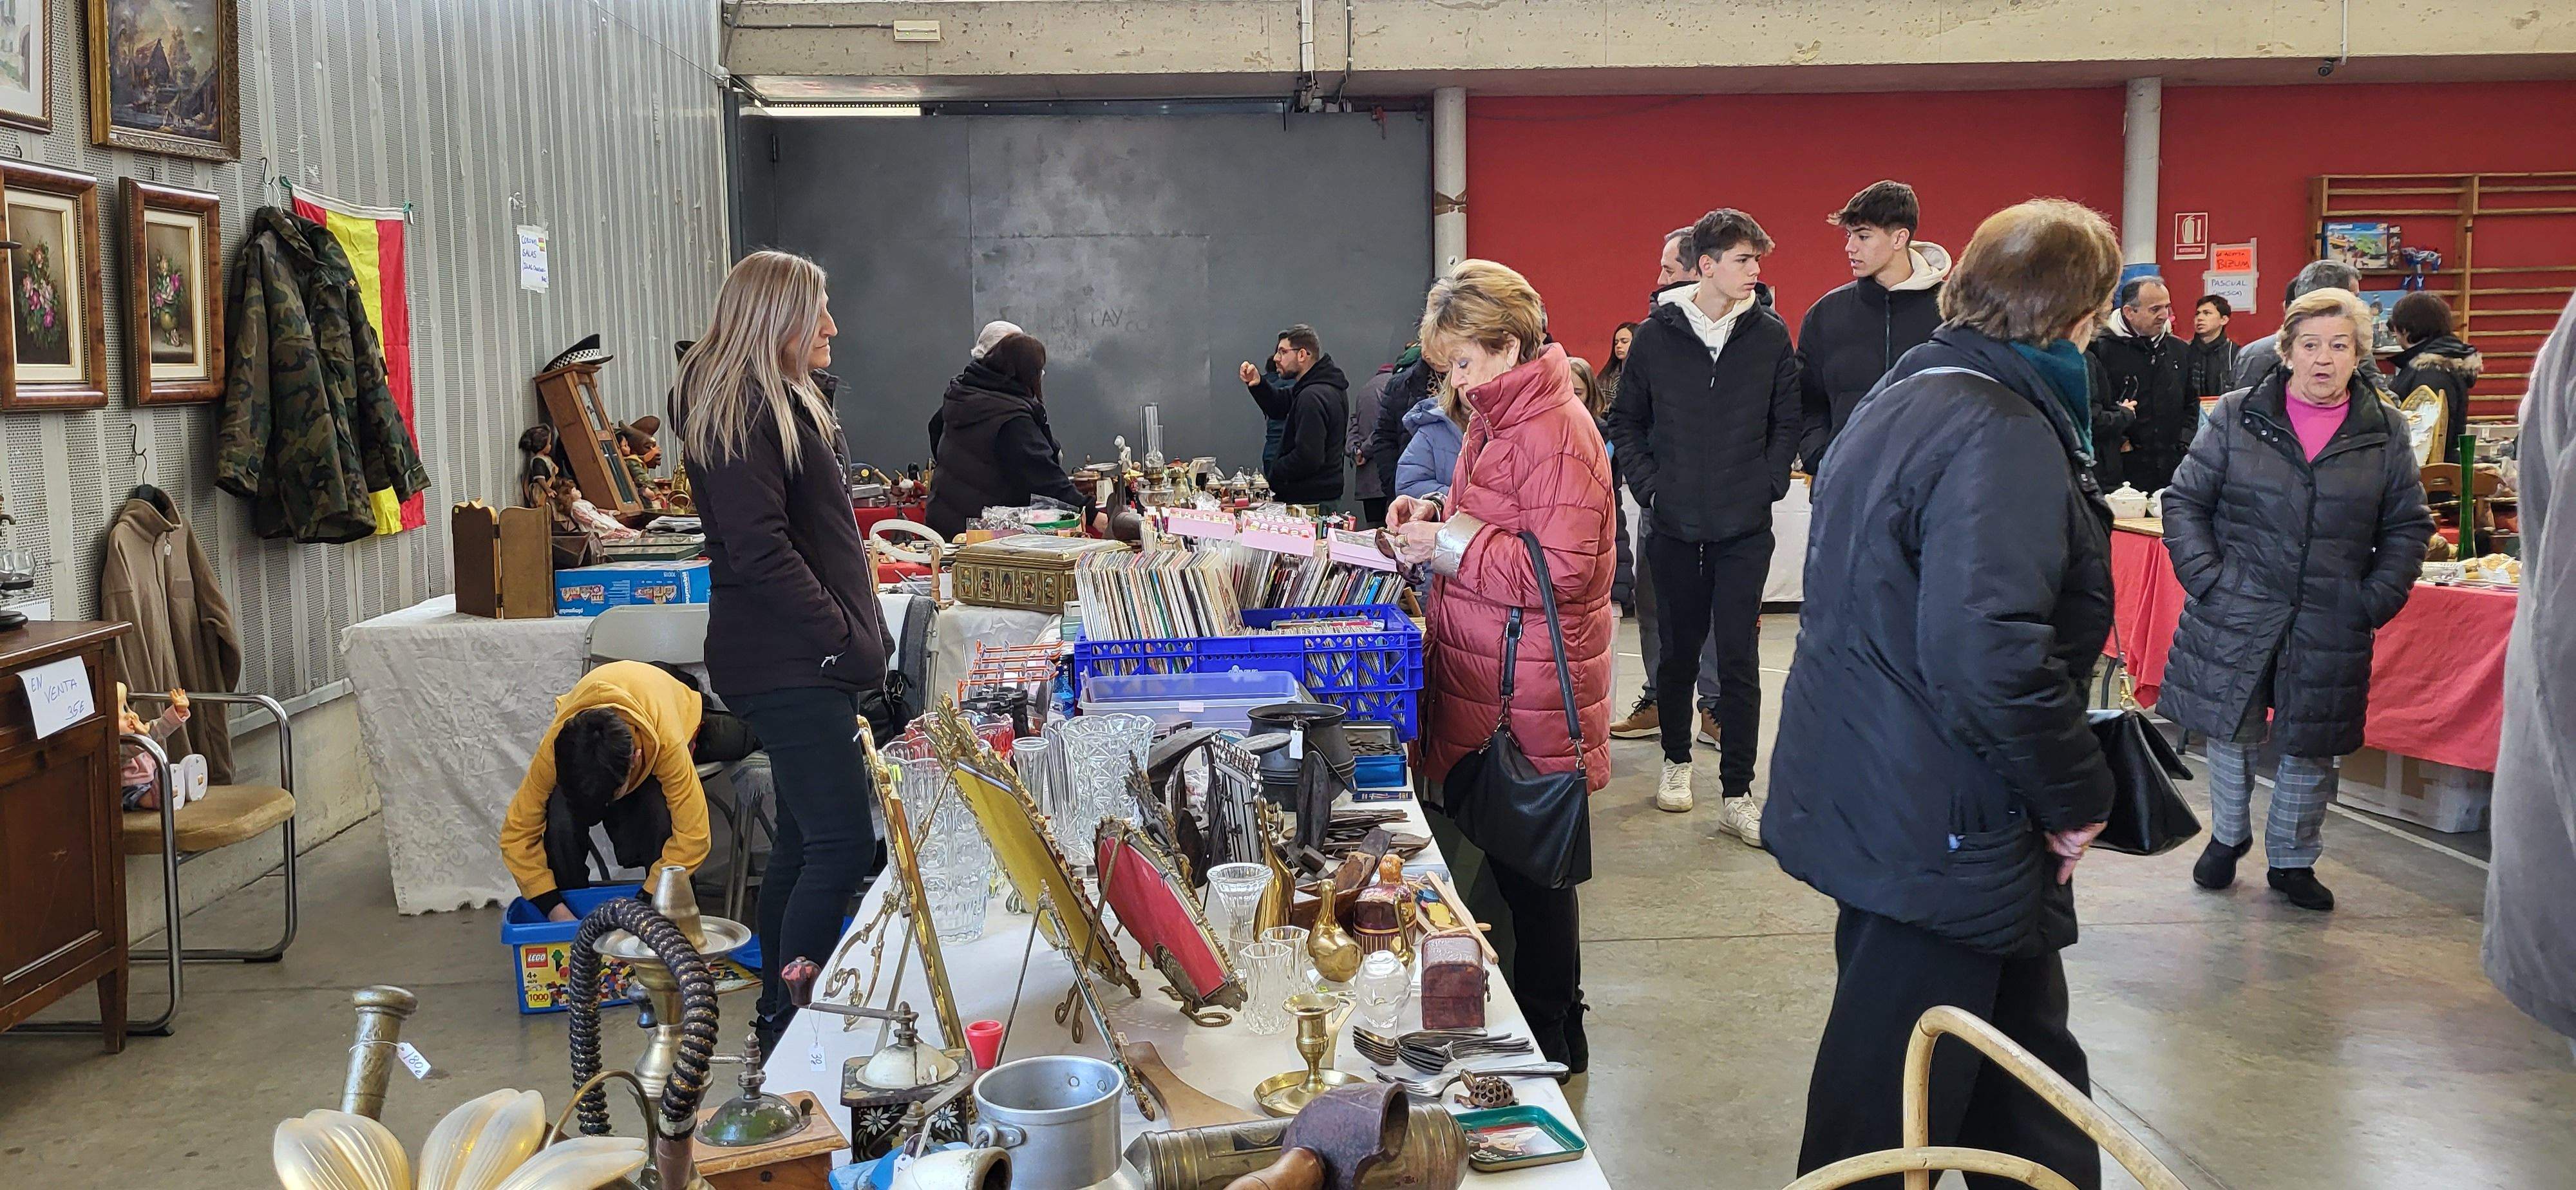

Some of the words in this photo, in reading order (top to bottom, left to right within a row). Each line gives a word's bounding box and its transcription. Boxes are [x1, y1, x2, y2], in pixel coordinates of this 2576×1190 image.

[2216, 259, 2249, 270] BIZUM
[2211, 279, 2247, 287] PASCUAL
[31, 674, 42, 692] EN
[44, 679, 77, 704] VENTA
[527, 953, 547, 962] LEGO
[527, 971, 537, 979] 4+
[529, 993, 549, 1001] 1000
